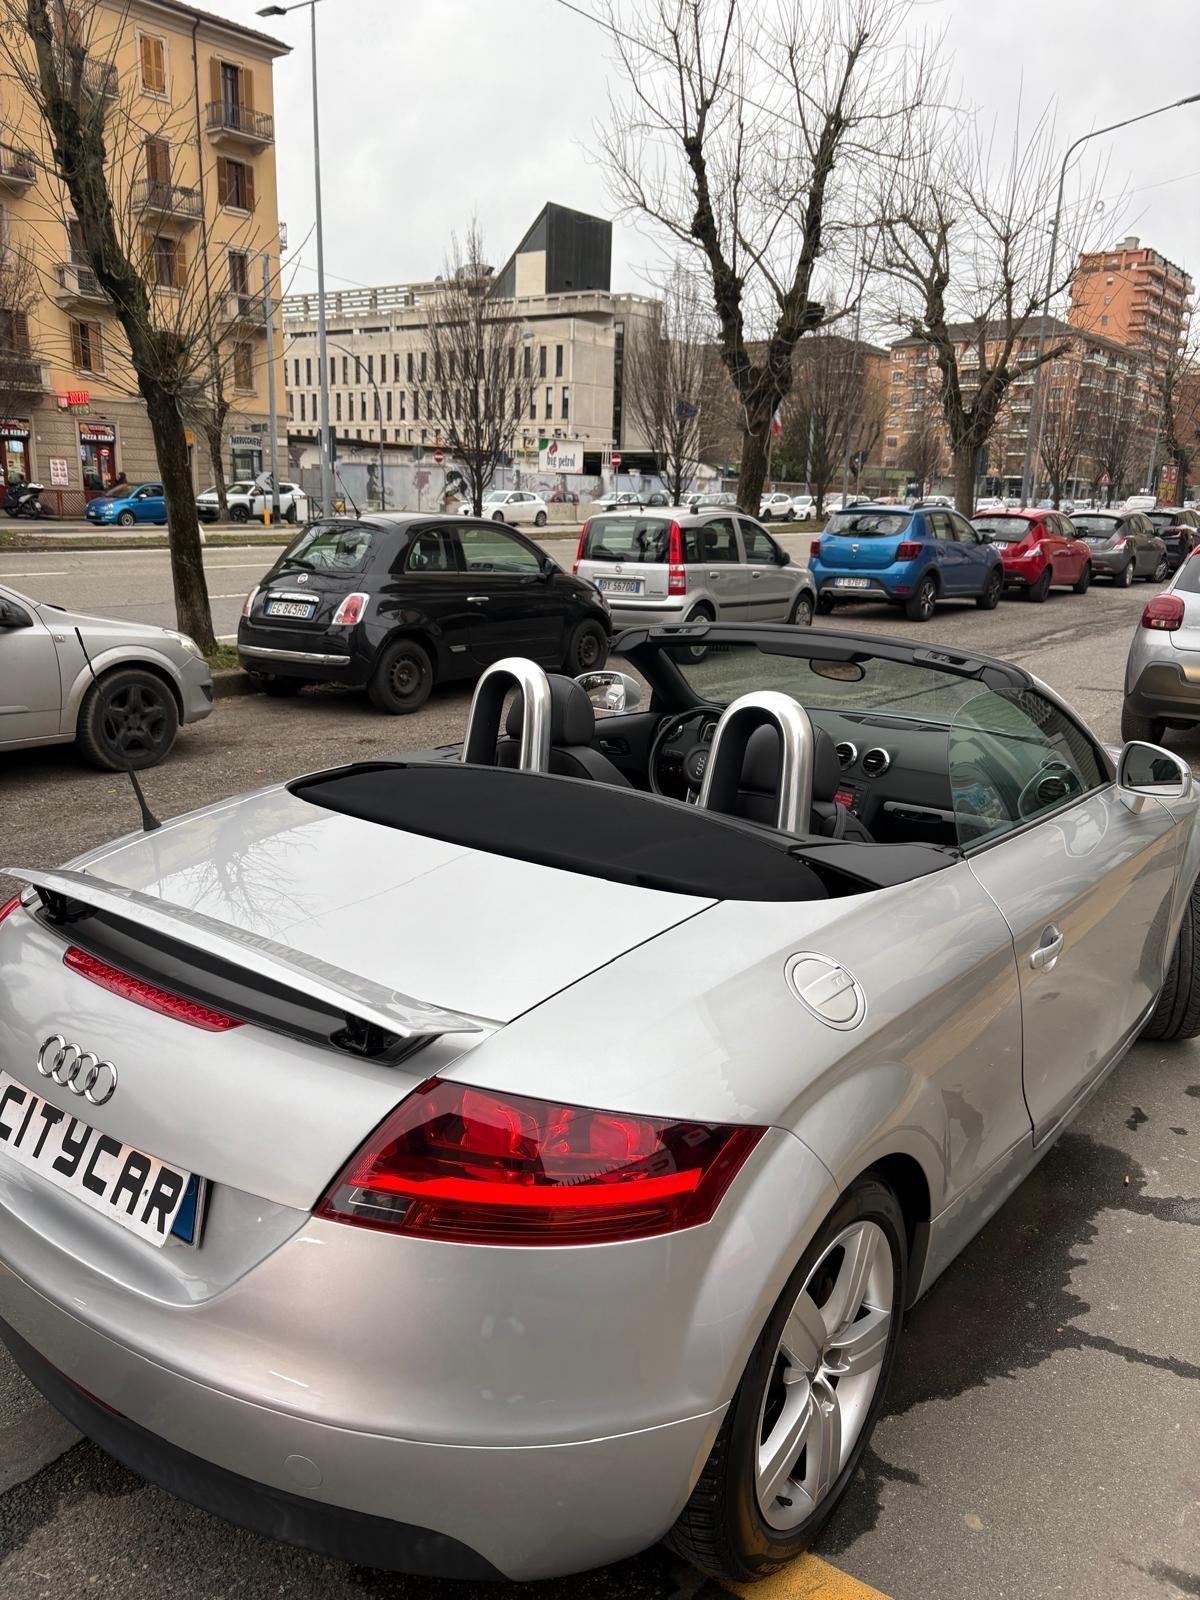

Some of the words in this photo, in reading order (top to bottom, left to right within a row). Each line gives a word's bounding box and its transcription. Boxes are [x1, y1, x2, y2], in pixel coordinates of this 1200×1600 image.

[547, 451, 557, 468] big
[558, 453, 576, 469] petrol
[0, 1084, 184, 1235] CITYCAR
